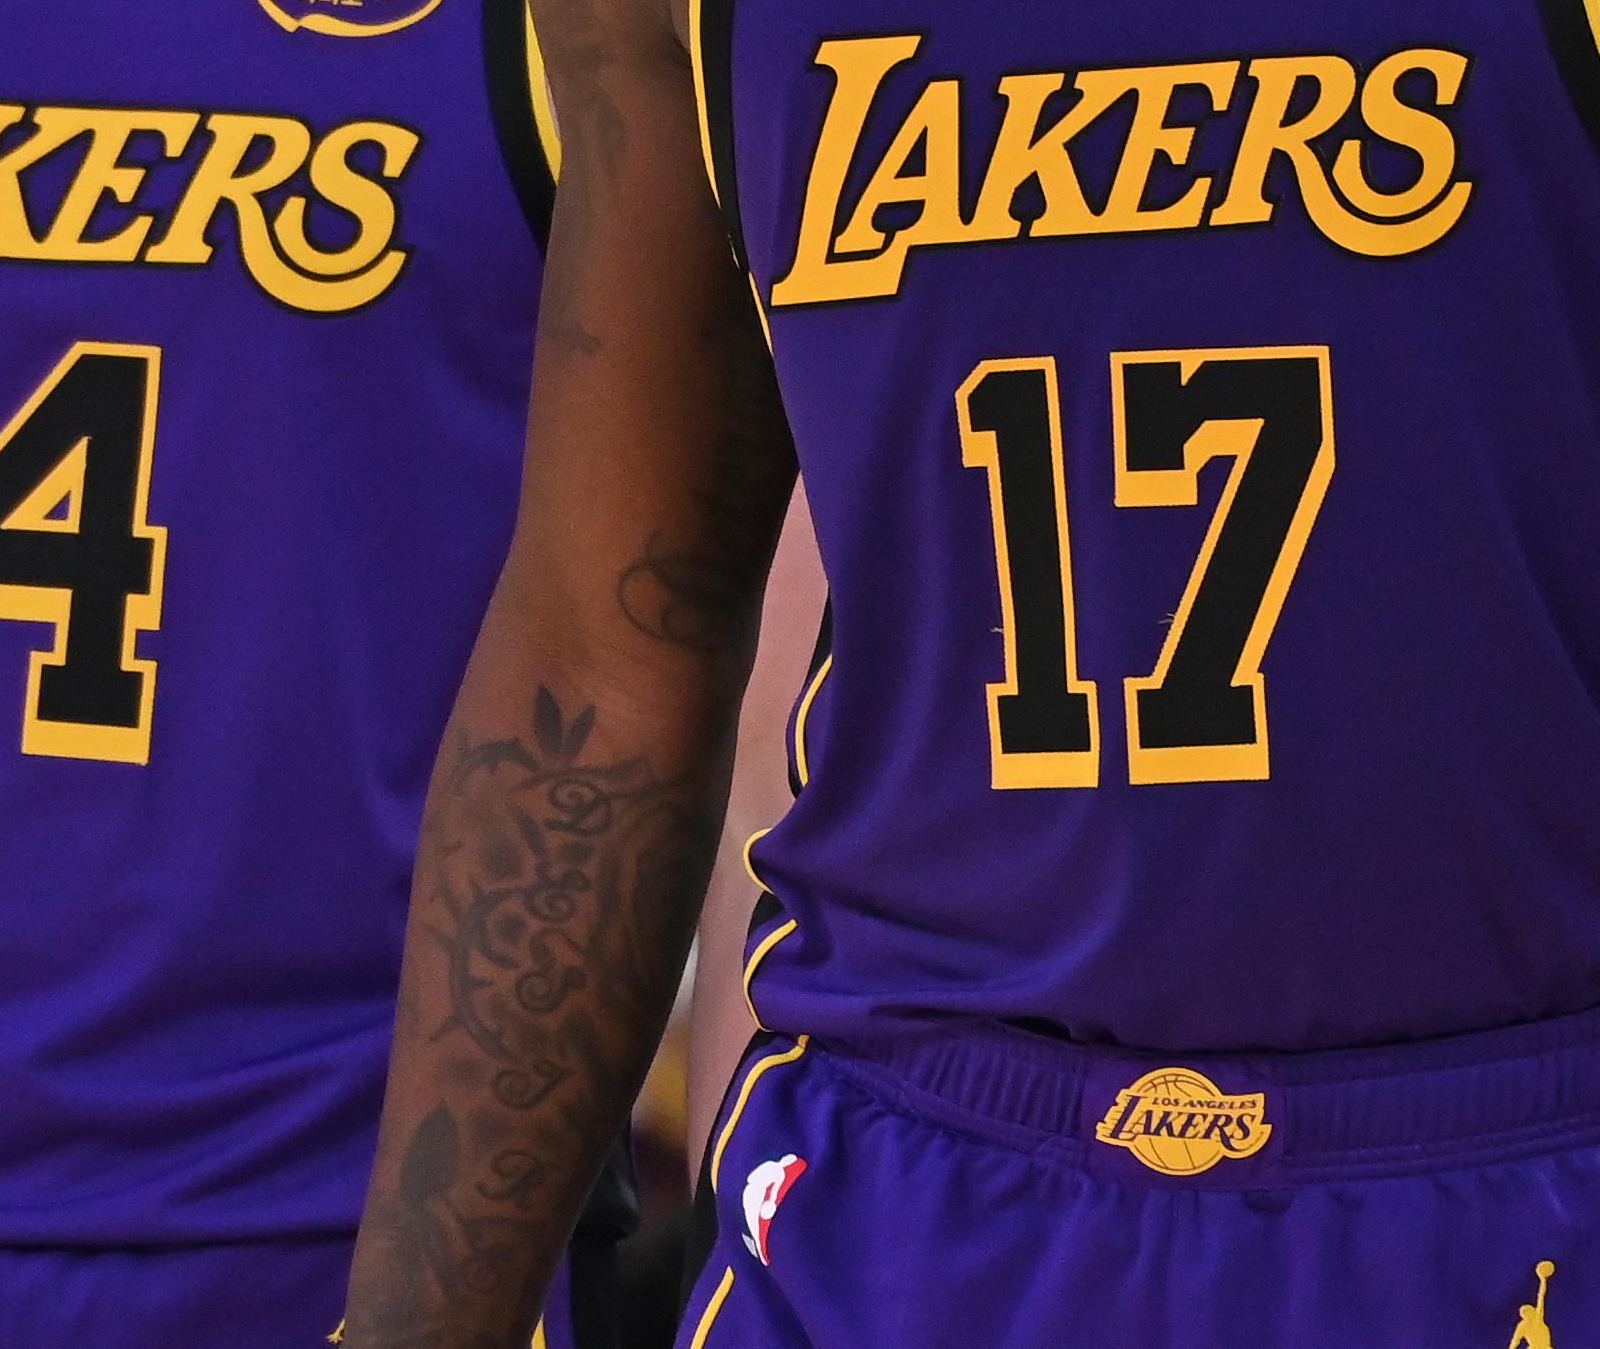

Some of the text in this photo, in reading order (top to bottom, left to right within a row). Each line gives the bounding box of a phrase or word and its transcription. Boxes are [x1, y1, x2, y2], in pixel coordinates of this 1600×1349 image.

[770, 34, 1475, 307] LAKERS
[954, 345, 1336, 790] 17
[1103, 1094, 1265, 1153] LAKERS
[1151, 1096, 1258, 1110] LOS ANGELES
